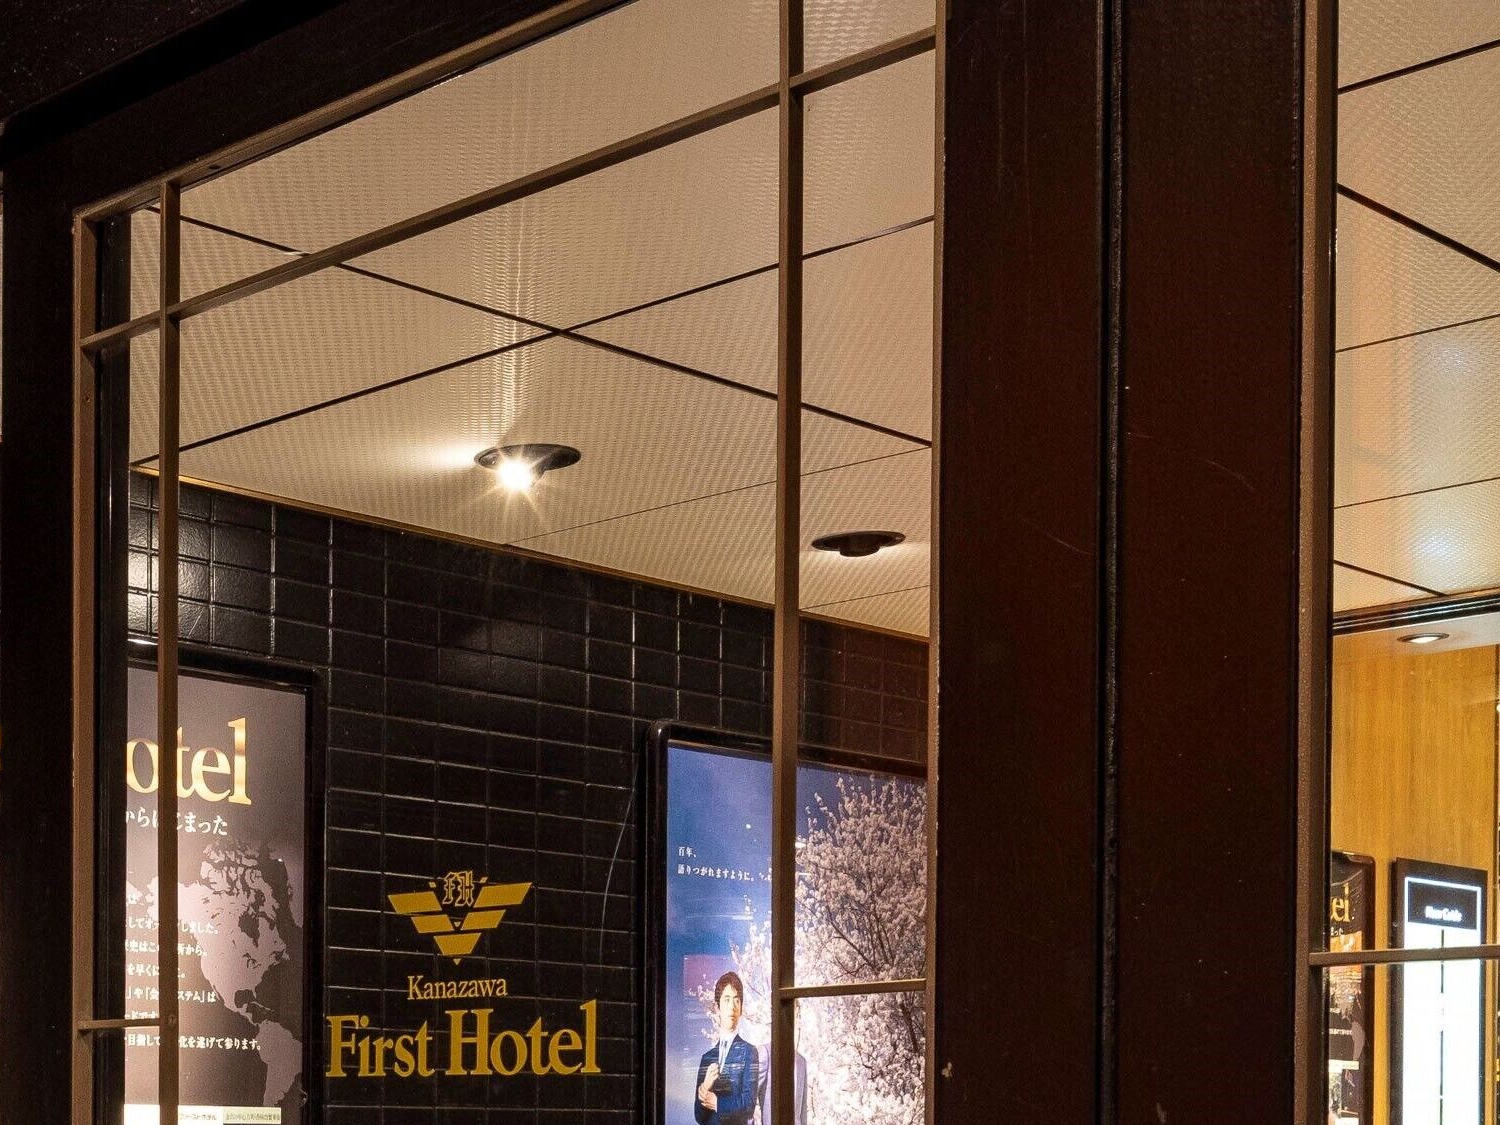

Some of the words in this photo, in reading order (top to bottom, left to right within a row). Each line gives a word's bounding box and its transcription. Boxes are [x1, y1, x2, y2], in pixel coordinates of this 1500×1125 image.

[407, 975, 508, 1000] Kanazawa
[325, 1014, 436, 1078] First
[445, 999, 601, 1076] Hotel
